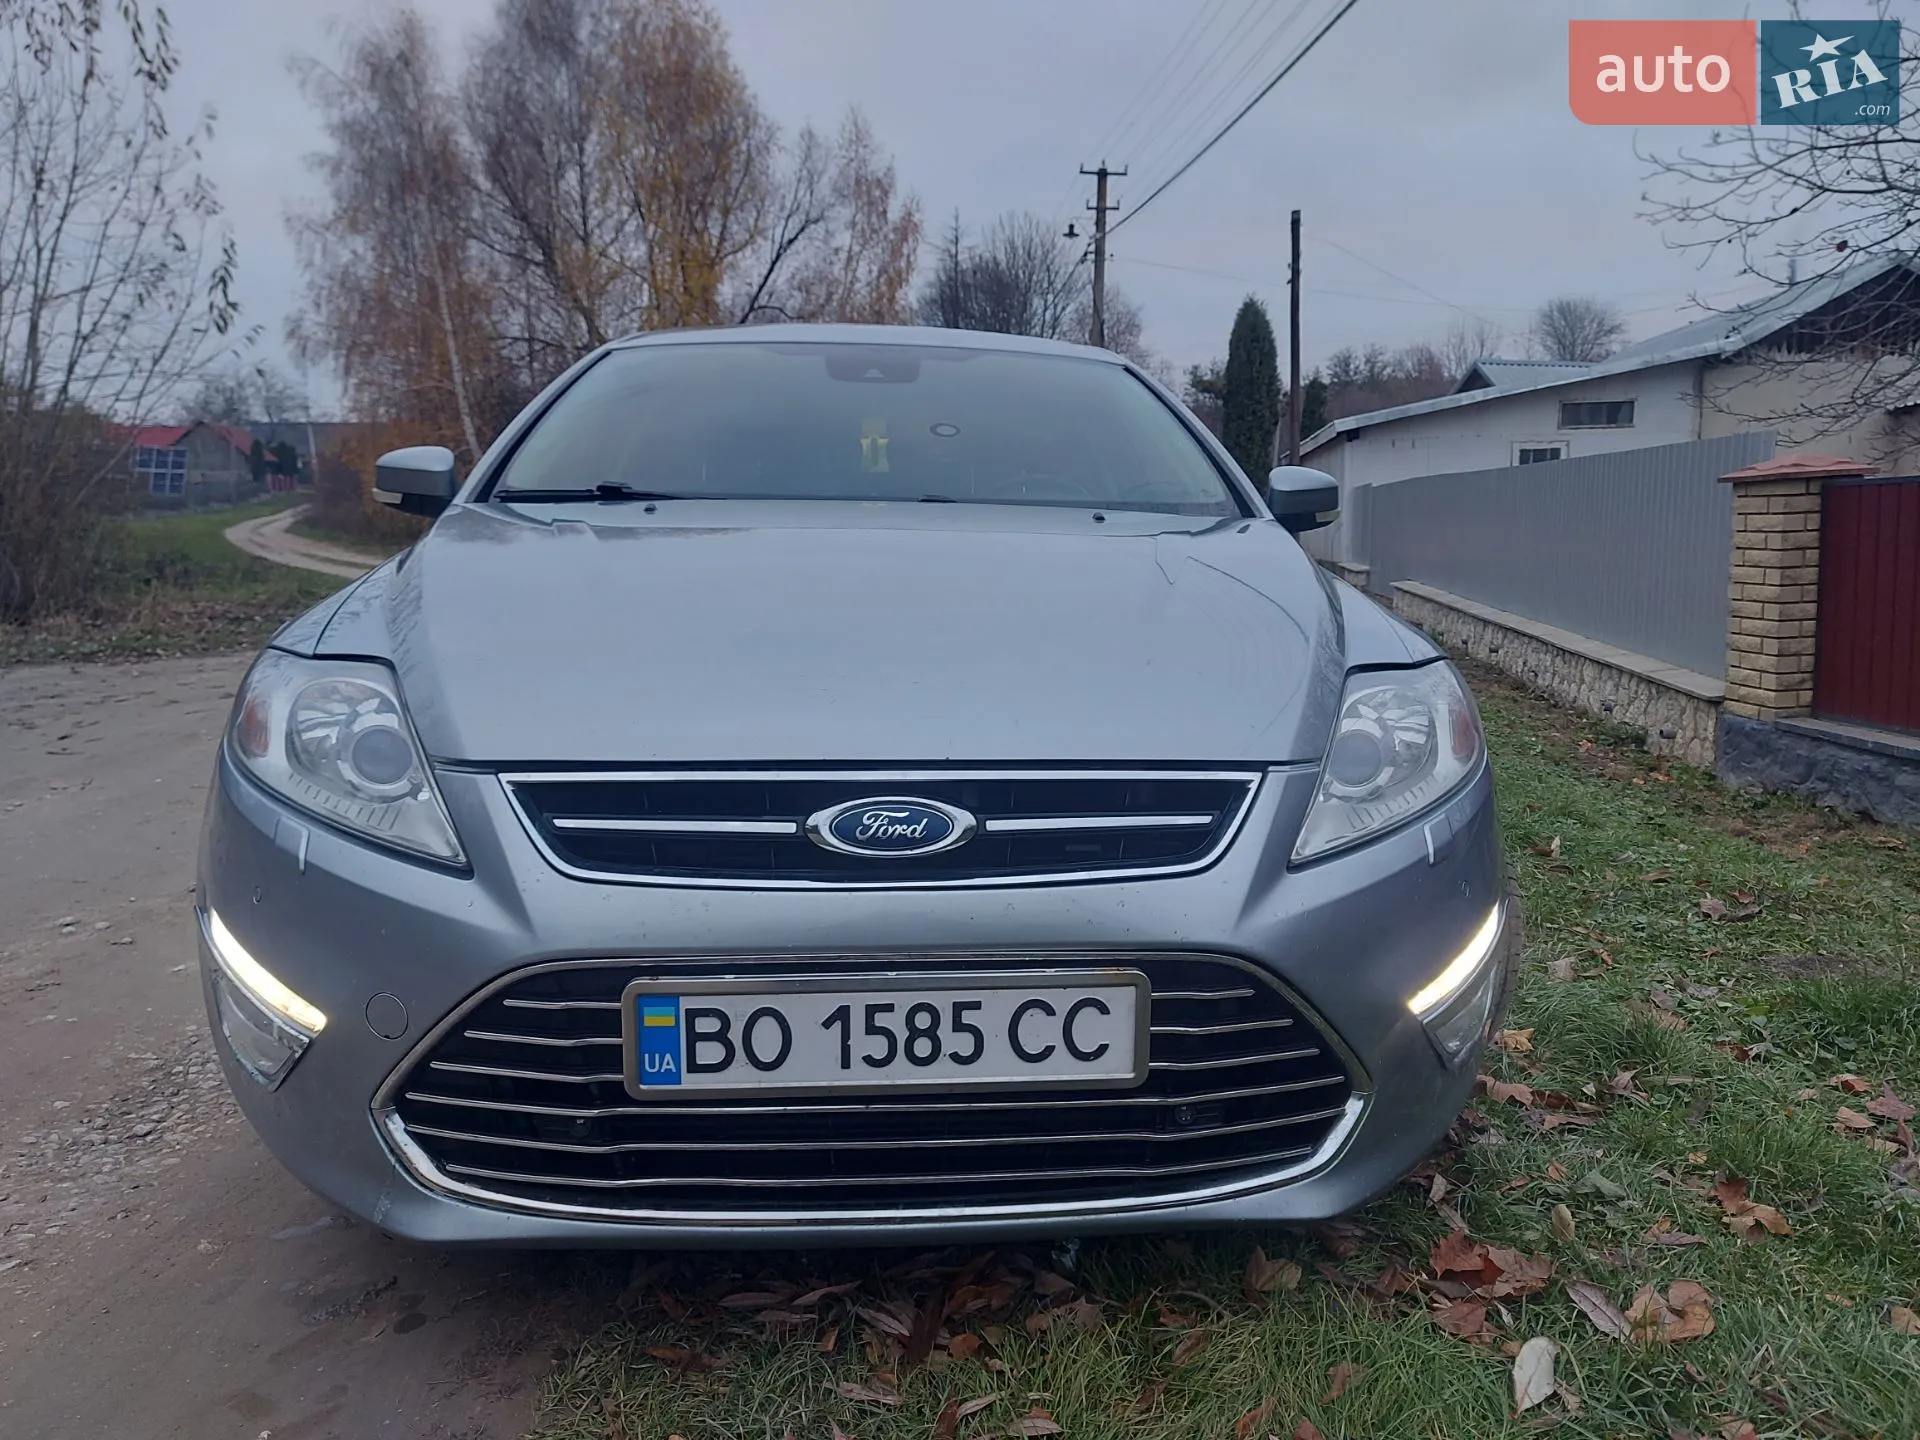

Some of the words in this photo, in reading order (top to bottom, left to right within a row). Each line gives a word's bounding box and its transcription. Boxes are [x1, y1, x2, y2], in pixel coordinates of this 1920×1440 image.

[855, 811, 929, 842] Ford
[684, 1006, 793, 1074] BO
[820, 1000, 985, 1070] 1585
[1008, 996, 1111, 1064] CC
[643, 1053, 677, 1073] UA
